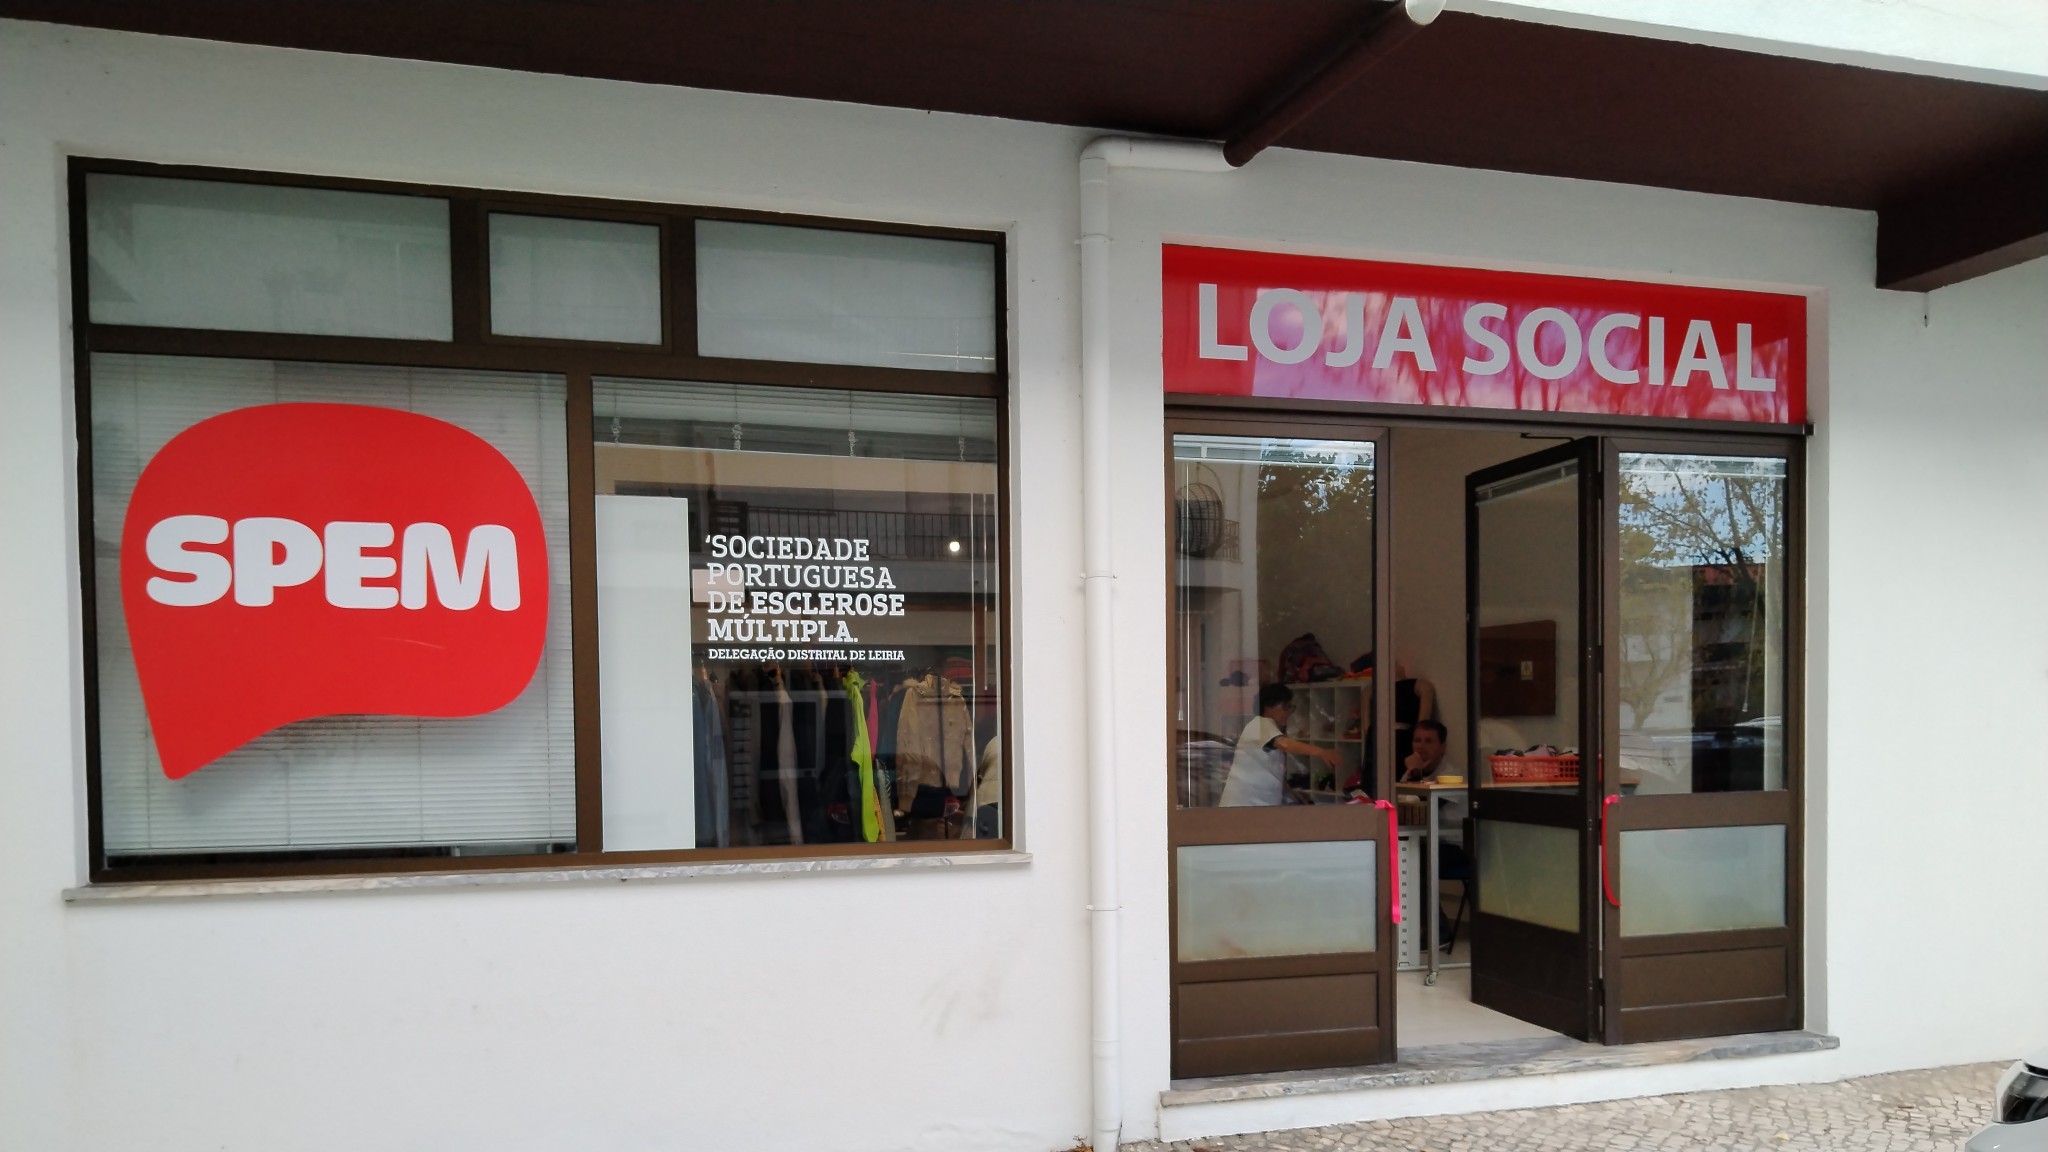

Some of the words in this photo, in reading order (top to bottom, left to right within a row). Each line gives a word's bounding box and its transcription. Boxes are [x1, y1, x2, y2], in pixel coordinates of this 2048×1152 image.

[1198, 282, 1438, 372] LOJA
[1461, 302, 1777, 392] SOCIAL
[145, 514, 521, 612] SPEM
[706, 562, 897, 589] PORTUGUESA
[707, 590, 745, 614] DE
[751, 591, 905, 616] ESCLEROSE
[707, 613, 859, 643] MÚLTIPLA.
[708, 647, 786, 663] DELEGAÇÃO
[787, 649, 848, 661] DISTRITAL
[849, 650, 866, 661] DE
[868, 650, 906, 661] LEIRIA
